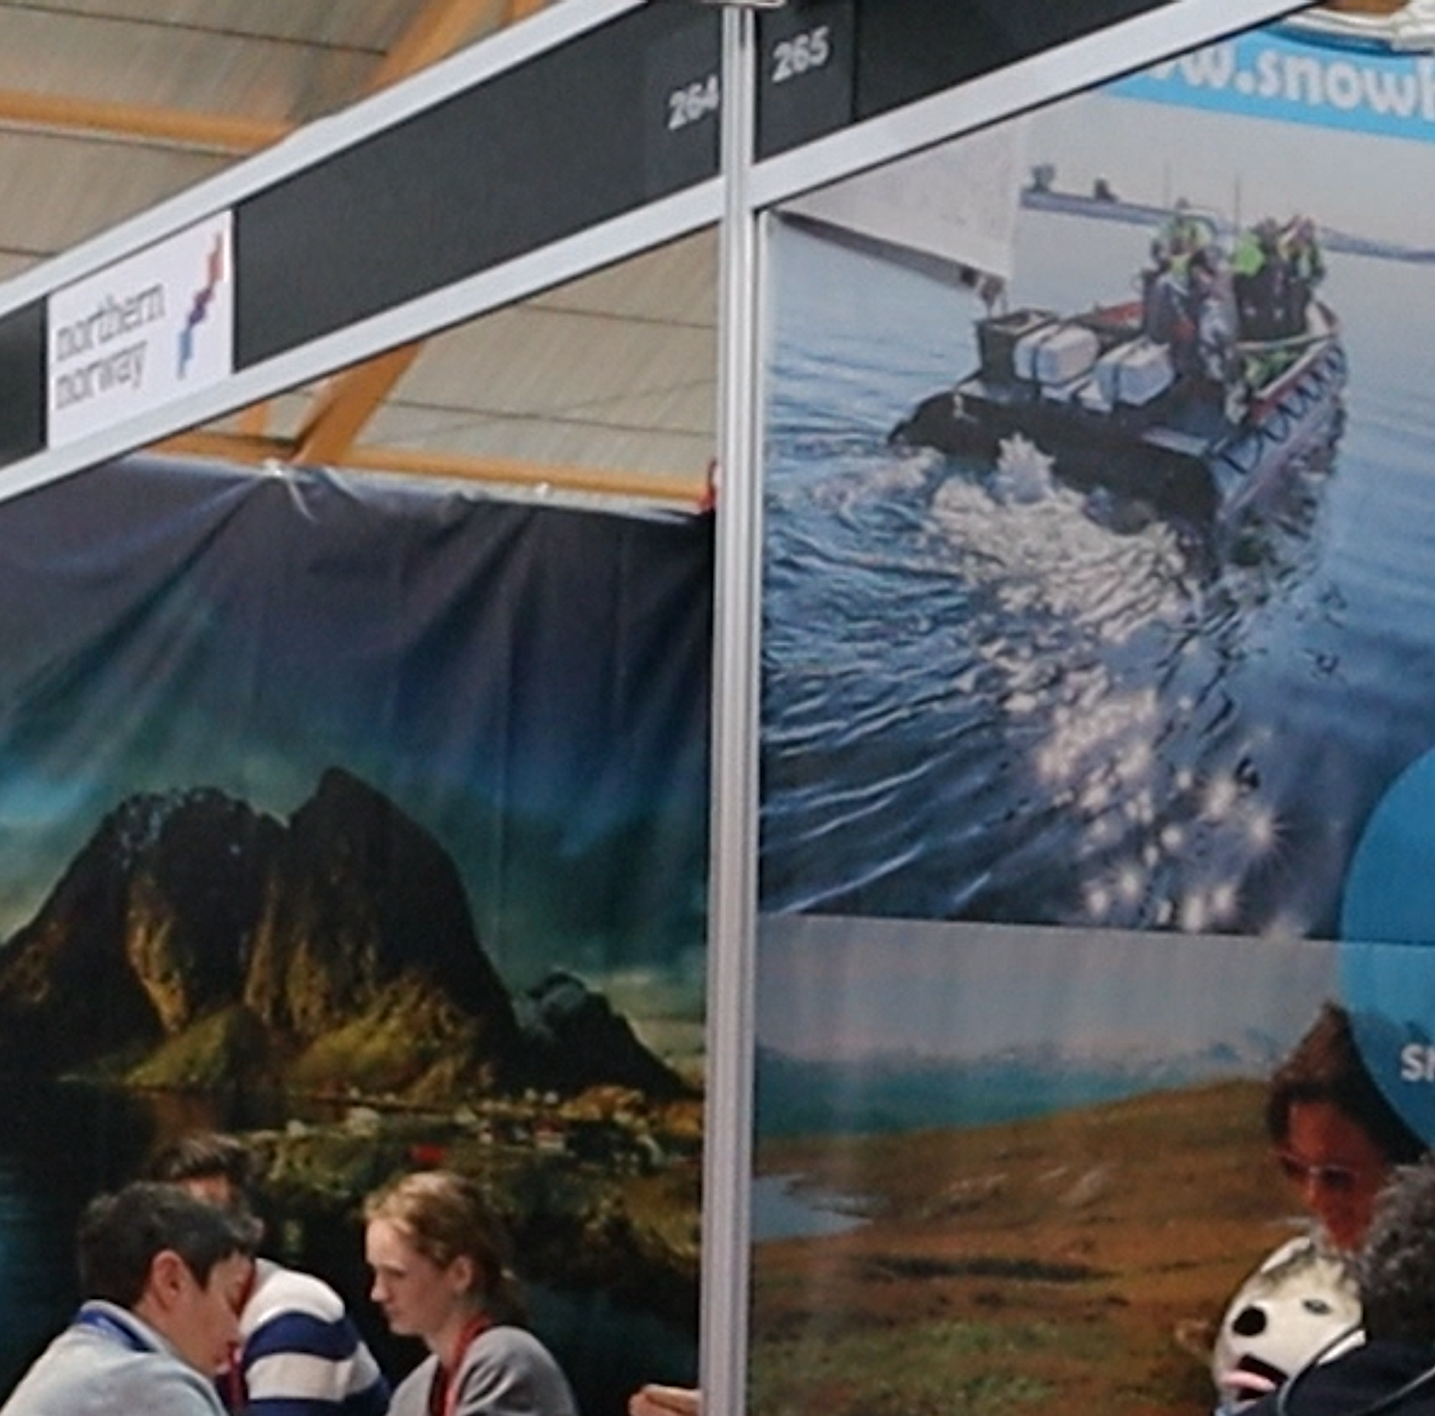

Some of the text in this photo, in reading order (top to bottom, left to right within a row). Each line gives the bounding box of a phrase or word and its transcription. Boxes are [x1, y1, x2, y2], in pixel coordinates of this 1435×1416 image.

[772, 25, 829, 83] 265
[667, 74, 719, 130] 264
[55, 282, 166, 363] northern
[55, 340, 148, 411] norway
